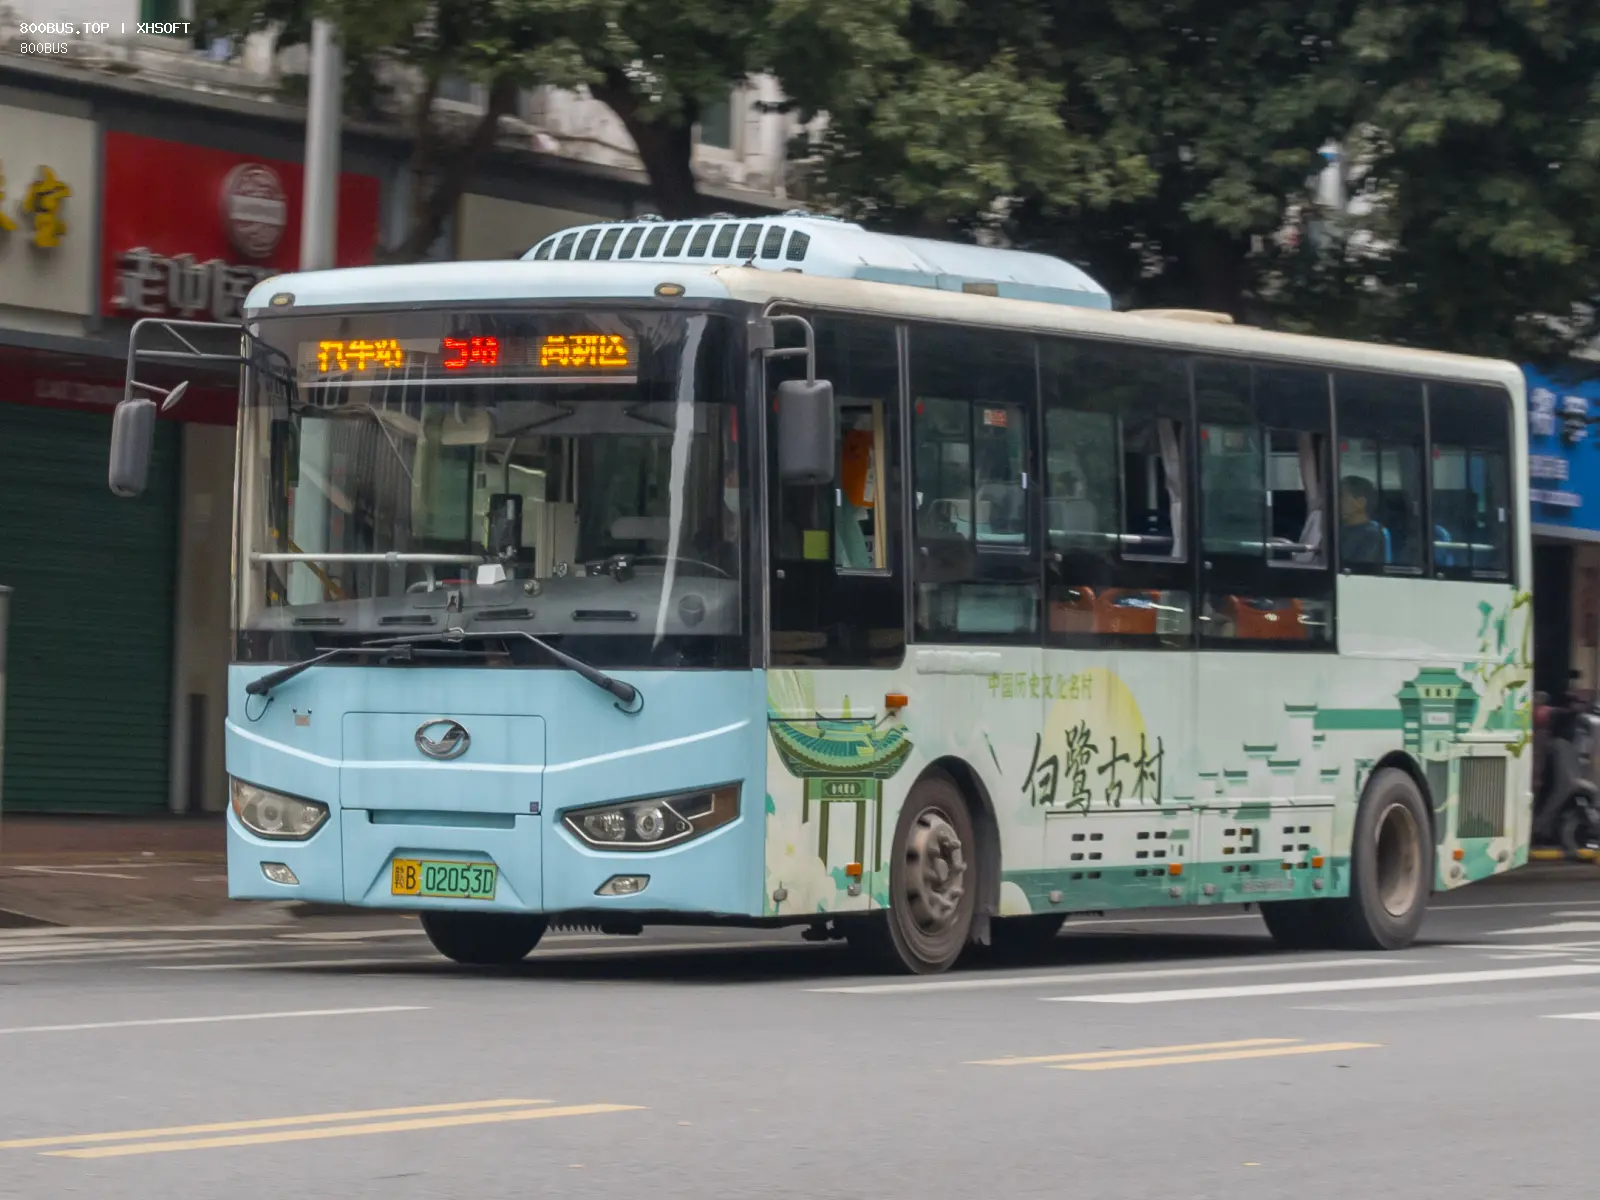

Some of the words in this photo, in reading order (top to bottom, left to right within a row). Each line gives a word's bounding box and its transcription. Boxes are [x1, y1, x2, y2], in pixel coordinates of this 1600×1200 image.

[987, 672, 1094, 700] 中国历史文化名村
[1021, 719, 1165, 817] 白鹭古村
